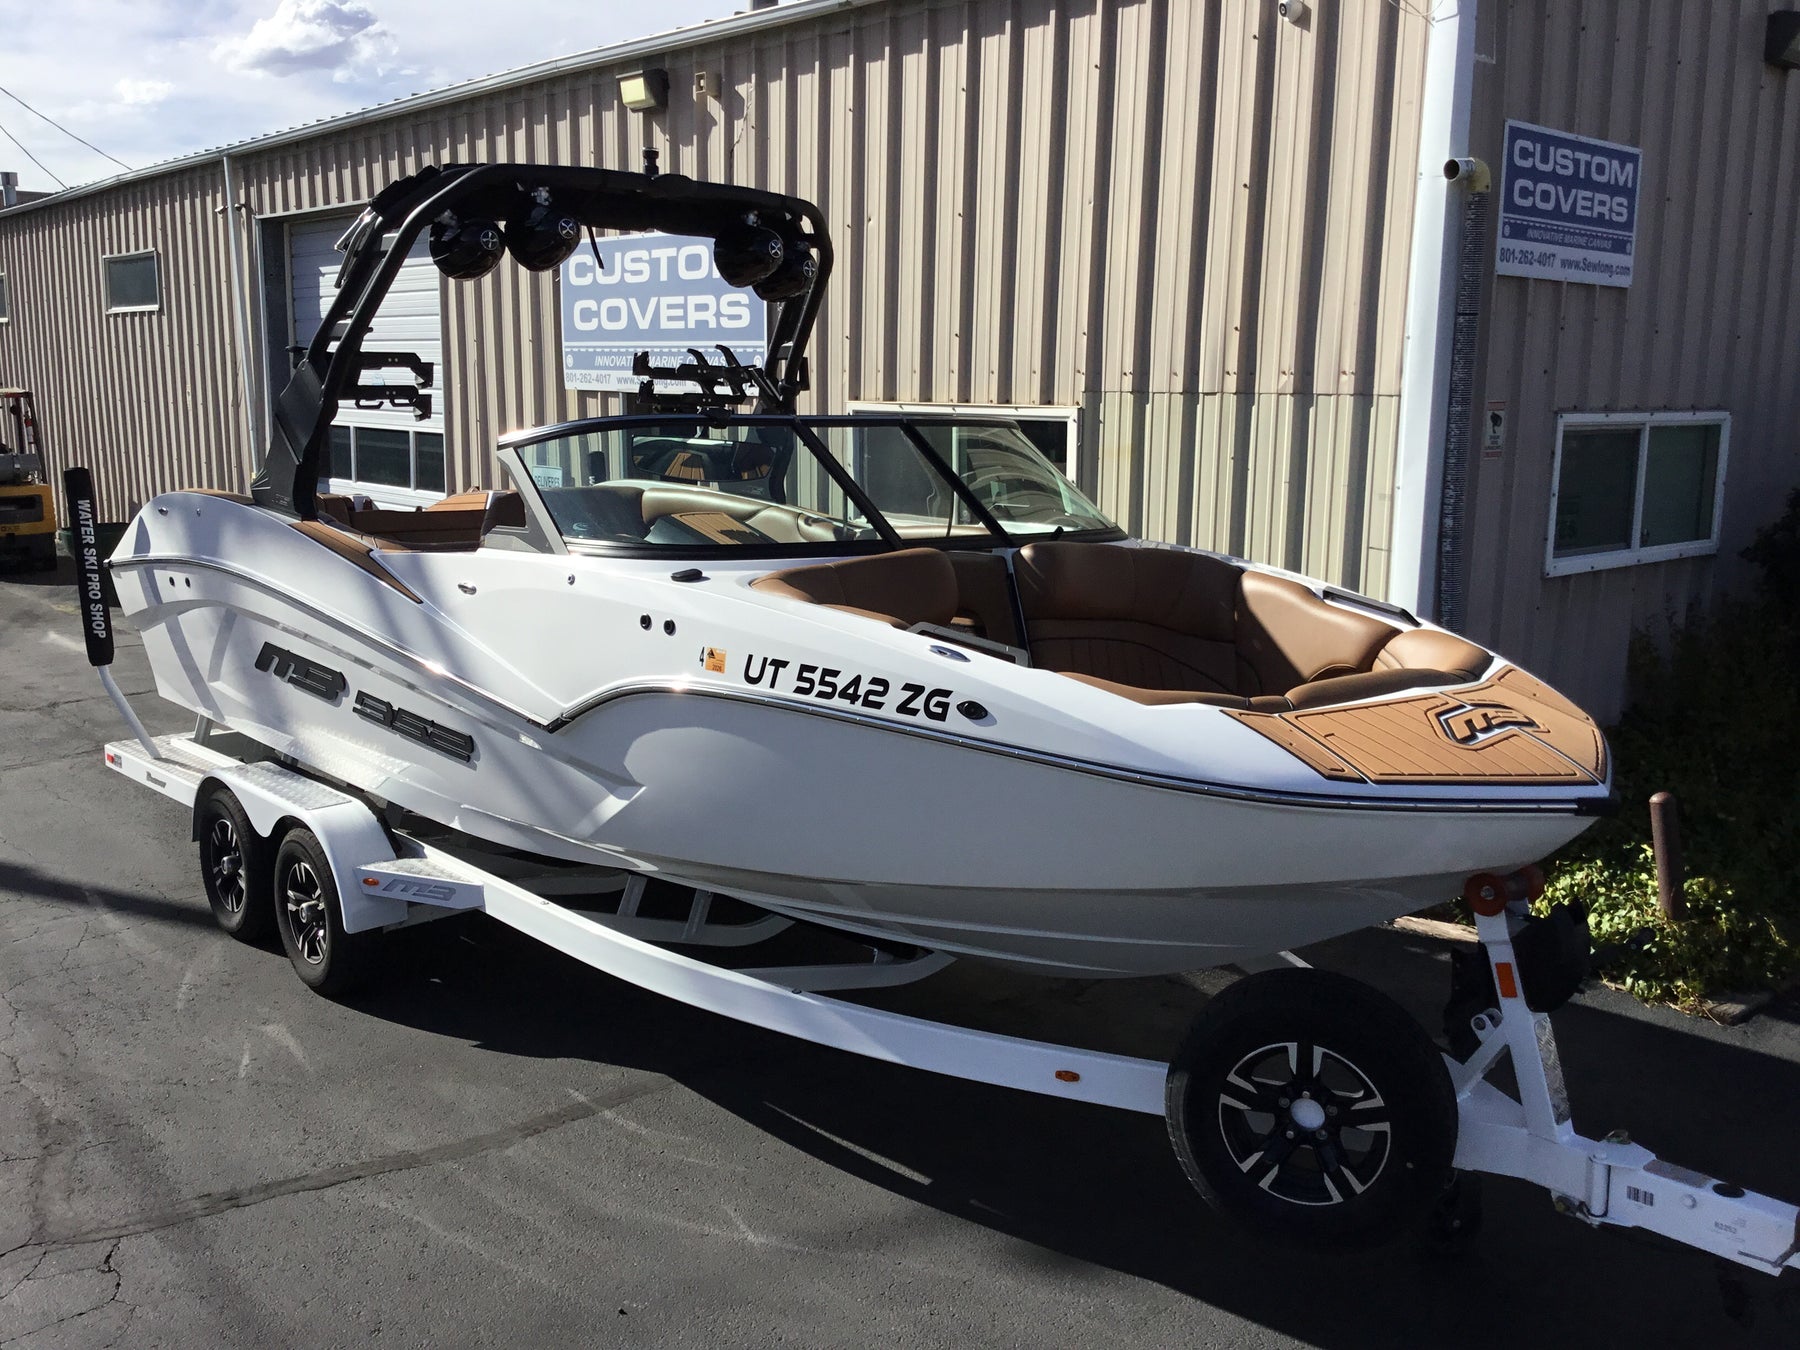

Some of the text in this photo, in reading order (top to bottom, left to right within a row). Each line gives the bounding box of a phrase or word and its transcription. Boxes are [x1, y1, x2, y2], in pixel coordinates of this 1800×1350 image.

[1513, 139, 1634, 188] CUSTOM
[1513, 179, 1629, 223] COVERS
[1500, 247, 1556, 268] 801-262-4017
[1526, 228, 1564, 243] INNOVATIVE
[1564, 234, 1588, 246] MARINE
[568, 244, 720, 287] CUSTO
[573, 292, 751, 332] COVERS
[565, 371, 612, 386] 801-262-4017
[594, 355, 634, 367] INNOVATI
[648, 355, 684, 368] MARINE
[77, 499, 107, 639] WATER SKI PRO SHOP
[743, 653, 954, 722] UT 5542 ZG
